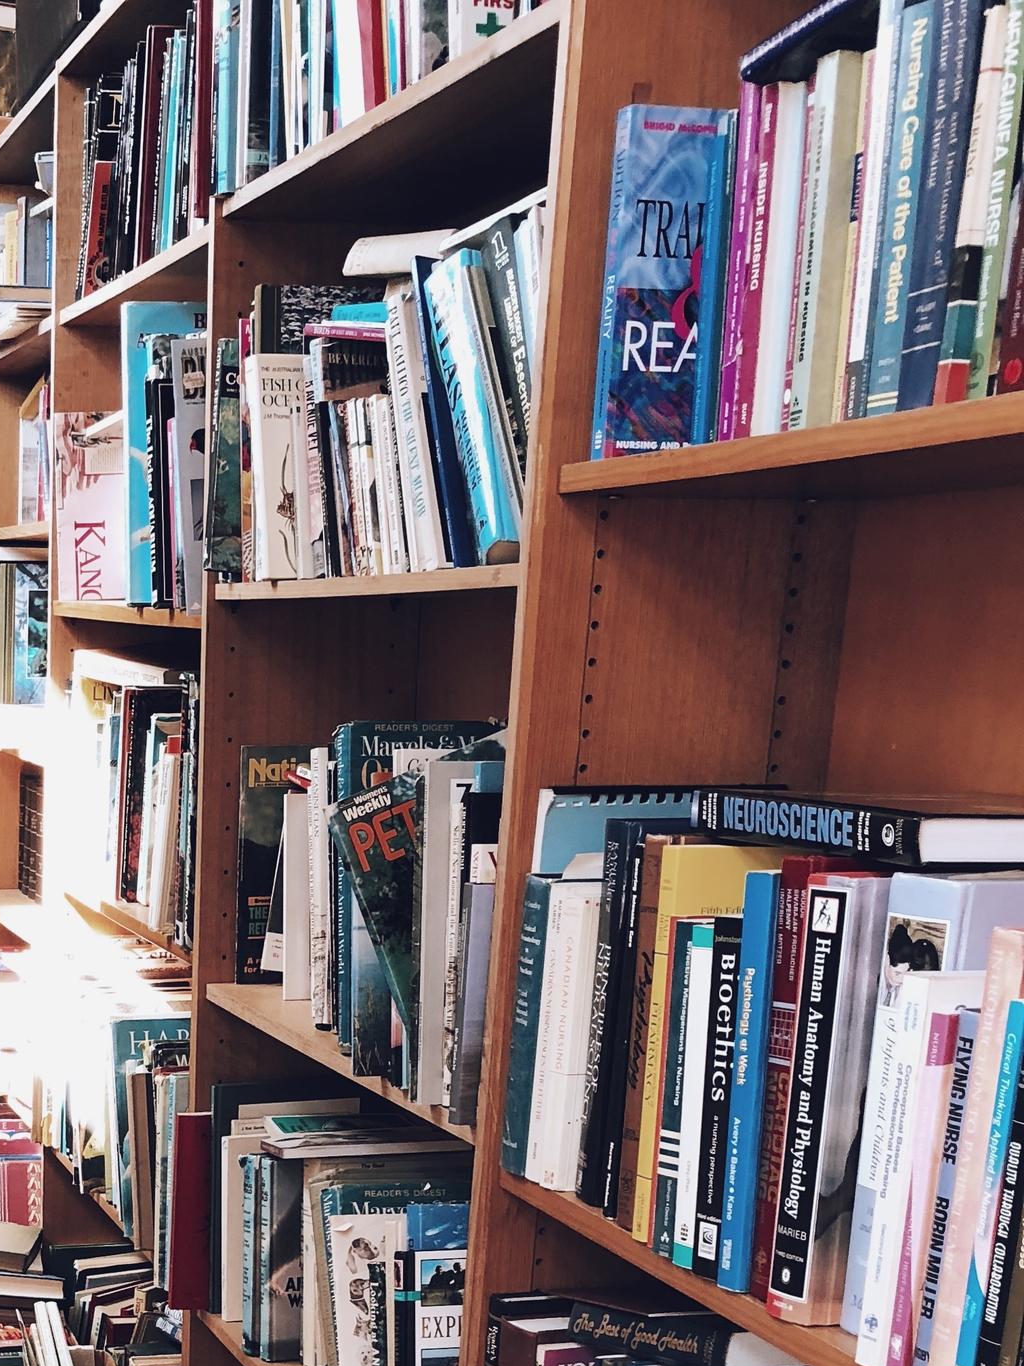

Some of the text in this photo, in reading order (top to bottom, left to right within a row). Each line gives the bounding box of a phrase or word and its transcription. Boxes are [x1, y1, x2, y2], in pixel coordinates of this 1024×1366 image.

[883, 17, 929, 325] Nursing Care of the Patient
[749, 161, 769, 291] INSIDE NURSING
[615, 440, 658, 450] NURSING
[421, 723, 454, 733] DIGEST
[342, 792, 392, 821] Weekly
[723, 796, 854, 848] NEUROSCIENCE
[711, 953, 737, 1103] Bioethics
[735, 1054, 748, 1086] Work
[1002, 1032, 1017, 1076] Critical
[776, 937, 833, 1241] Human Anatomy and Physiology MARIEB
[992, 1078, 1011, 1128] Thinking
[731, 1116, 741, 1148] Avery
[988, 1130, 1003, 1180] Applied
[881, 1153, 894, 1199] Nursing
[919, 1035, 975, 1321] FLYING NURSE ROBIN MILLER
[1006, 1141, 1023, 1185] QUALITY
[573, 1312, 594, 1334] The
[593, 1313, 620, 1340] Best
[630, 1322, 659, 1349] Good
[658, 1326, 699, 1354] Health
